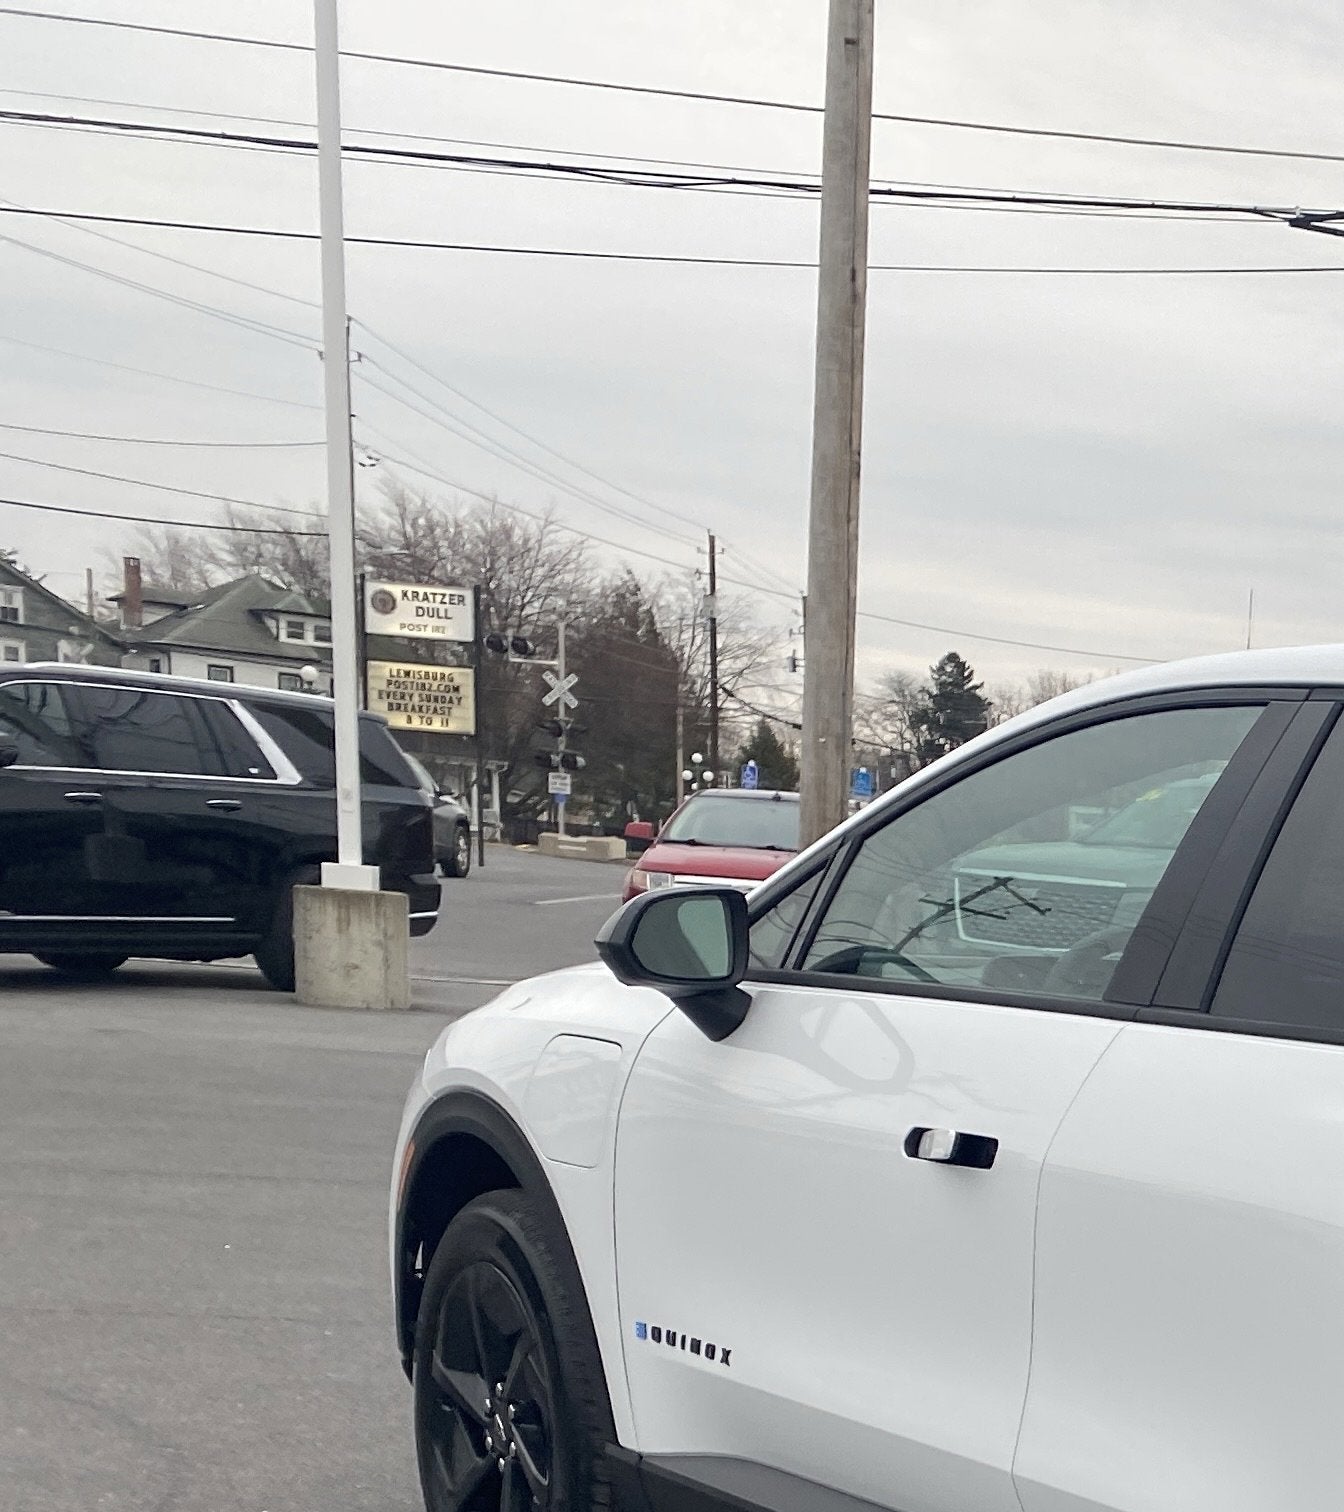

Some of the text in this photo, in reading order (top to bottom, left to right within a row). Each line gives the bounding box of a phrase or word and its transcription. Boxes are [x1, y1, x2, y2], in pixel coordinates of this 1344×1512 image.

[401, 589, 466, 606] KRATZER
[415, 606, 453, 620] DULL
[399, 622, 446, 635] POST 182
[389, 667, 455, 683] LEWISBURG
[386, 679, 461, 694] POST182.COM
[378, 690, 462, 706] EVERY SUNDAY
[387, 702, 453, 717] BREAKFAST
[419, 715, 433, 726] TO
[440, 716, 449, 728] 11
[636, 1321, 732, 1367] EQUINOX
